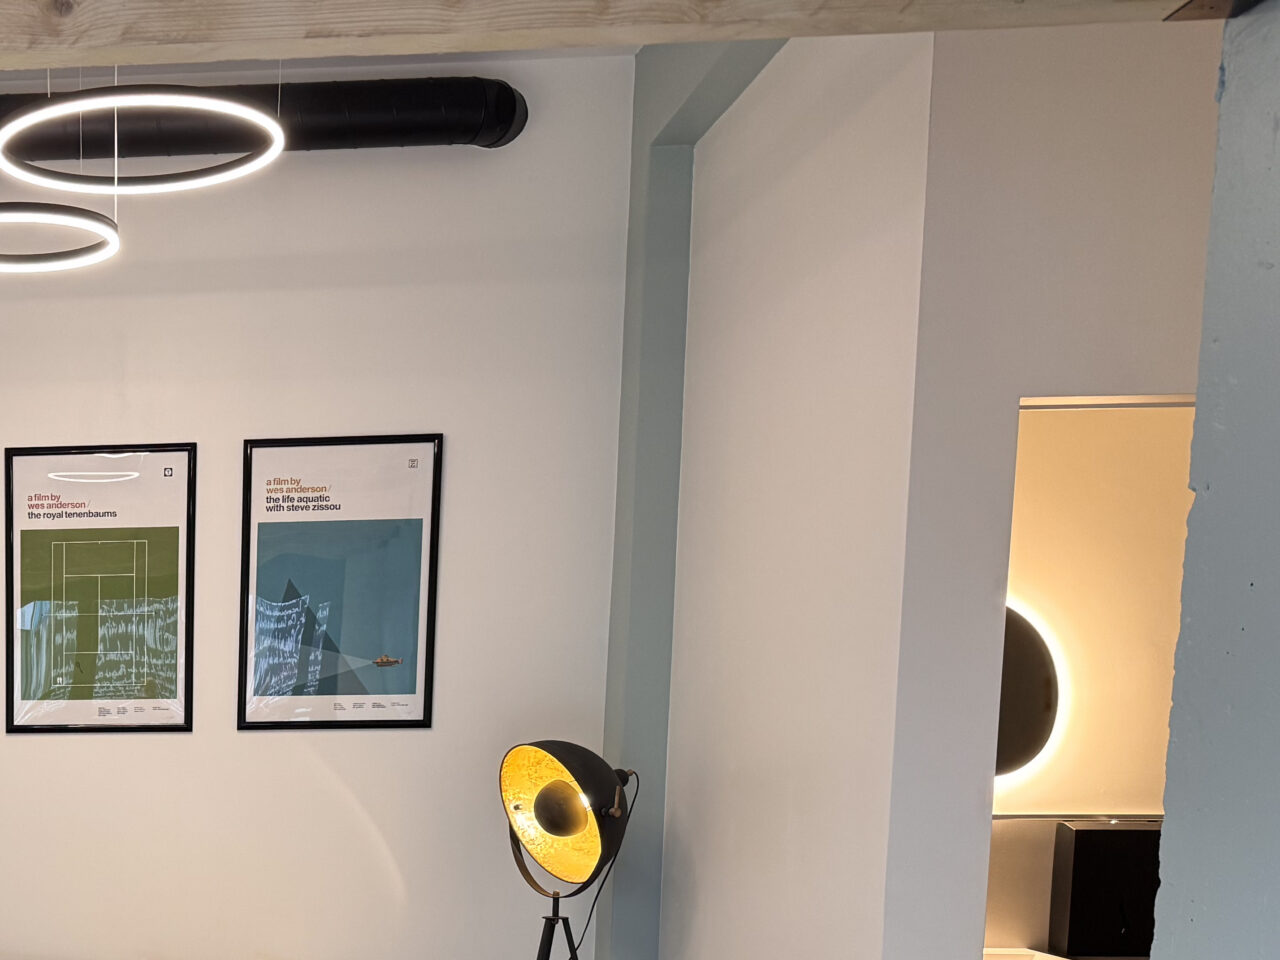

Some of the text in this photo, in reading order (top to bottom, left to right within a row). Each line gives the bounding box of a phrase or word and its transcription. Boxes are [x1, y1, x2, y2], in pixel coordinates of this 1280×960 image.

[273, 478, 289, 486] film
[290, 477, 301, 487] by
[285, 485, 327, 494] anderson
[34, 494, 49, 502] film
[50, 493, 61, 503] by
[266, 494, 331, 505] the life aquatic
[46, 501, 86, 509] anderson
[265, 503, 341, 512] with steve zissou
[27, 510, 117, 520] the royal tenenbaums
